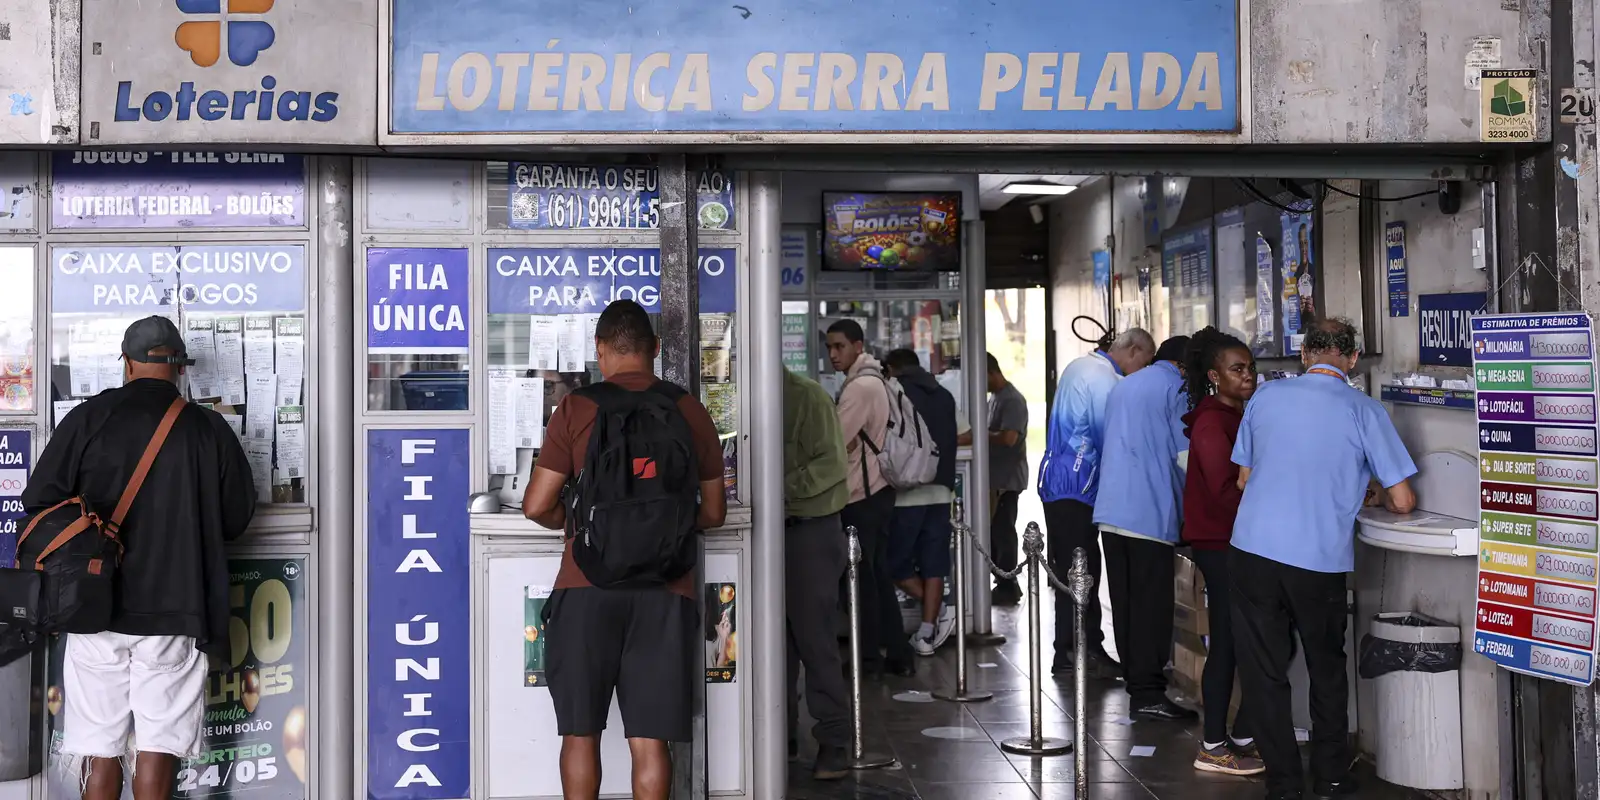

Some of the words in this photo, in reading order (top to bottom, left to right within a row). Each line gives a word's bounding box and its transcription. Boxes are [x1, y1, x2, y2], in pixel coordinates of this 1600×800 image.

[415, 39, 712, 112] LOTÉRICA
[742, 51, 949, 112] SERRA
[979, 51, 1223, 112] PELADA
[114, 75, 339, 122] Loterias
[1488, 117, 1528, 125] ROMMA
[515, 165, 600, 190] GARANTA
[604, 167, 618, 191] O
[623, 168, 658, 192] SEU
[62, 195, 134, 216] LOTERIA
[139, 195, 212, 216] FEDERAL
[226, 192, 294, 216] BOLÕES
[547, 193, 584, 227] (61)
[588, 196, 661, 229] 99611-5
[853, 213, 921, 235] BOLÕES
[59, 252, 144, 275] CAIXA
[152, 252, 292, 274] EXCLUSIVO
[496, 255, 579, 276] CAIXA
[388, 264, 449, 290] FILA
[93, 284, 157, 306] PARA
[169, 283, 258, 305] JOGOS
[529, 286, 597, 307] PARA
[603, 285, 661, 307] JOG
[372, 298, 465, 332] ÚNICA
[1482, 319, 1527, 328] ESTIMATIVA
[1542, 317, 1578, 326] PRÊMIOS
[1421, 309, 1487, 348] RESULTAD
[1488, 370, 1525, 382] MEGA-SENA
[1489, 399, 1524, 413] LOTOFÁCIL
[1491, 430, 1511, 443] QUINA
[1493, 462, 1504, 472] DIA
[1505, 462, 1514, 473] DE
[1515, 463, 1535, 475] SORTE
[395, 439, 443, 573] FILA
[1492, 491, 1514, 504] DUPLA
[1515, 493, 1532, 506] SENA
[1492, 521, 1514, 535] SUPER
[1514, 523, 1532, 536] SETE
[1492, 551, 1528, 567] TIMEMANIA
[229, 571, 262, 582] STIMADO:
[285, 567, 298, 576] 18+
[1489, 581, 1528, 598] LOTOMANIA
[1488, 611, 1514, 627] LOTECA
[1485, 641, 1514, 658] FEDERAL
[394, 614, 443, 788] ÚNICA
[215, 726, 233, 736] UM
[234, 719, 273, 734] BOLÃO
[177, 757, 278, 792] 24/05
